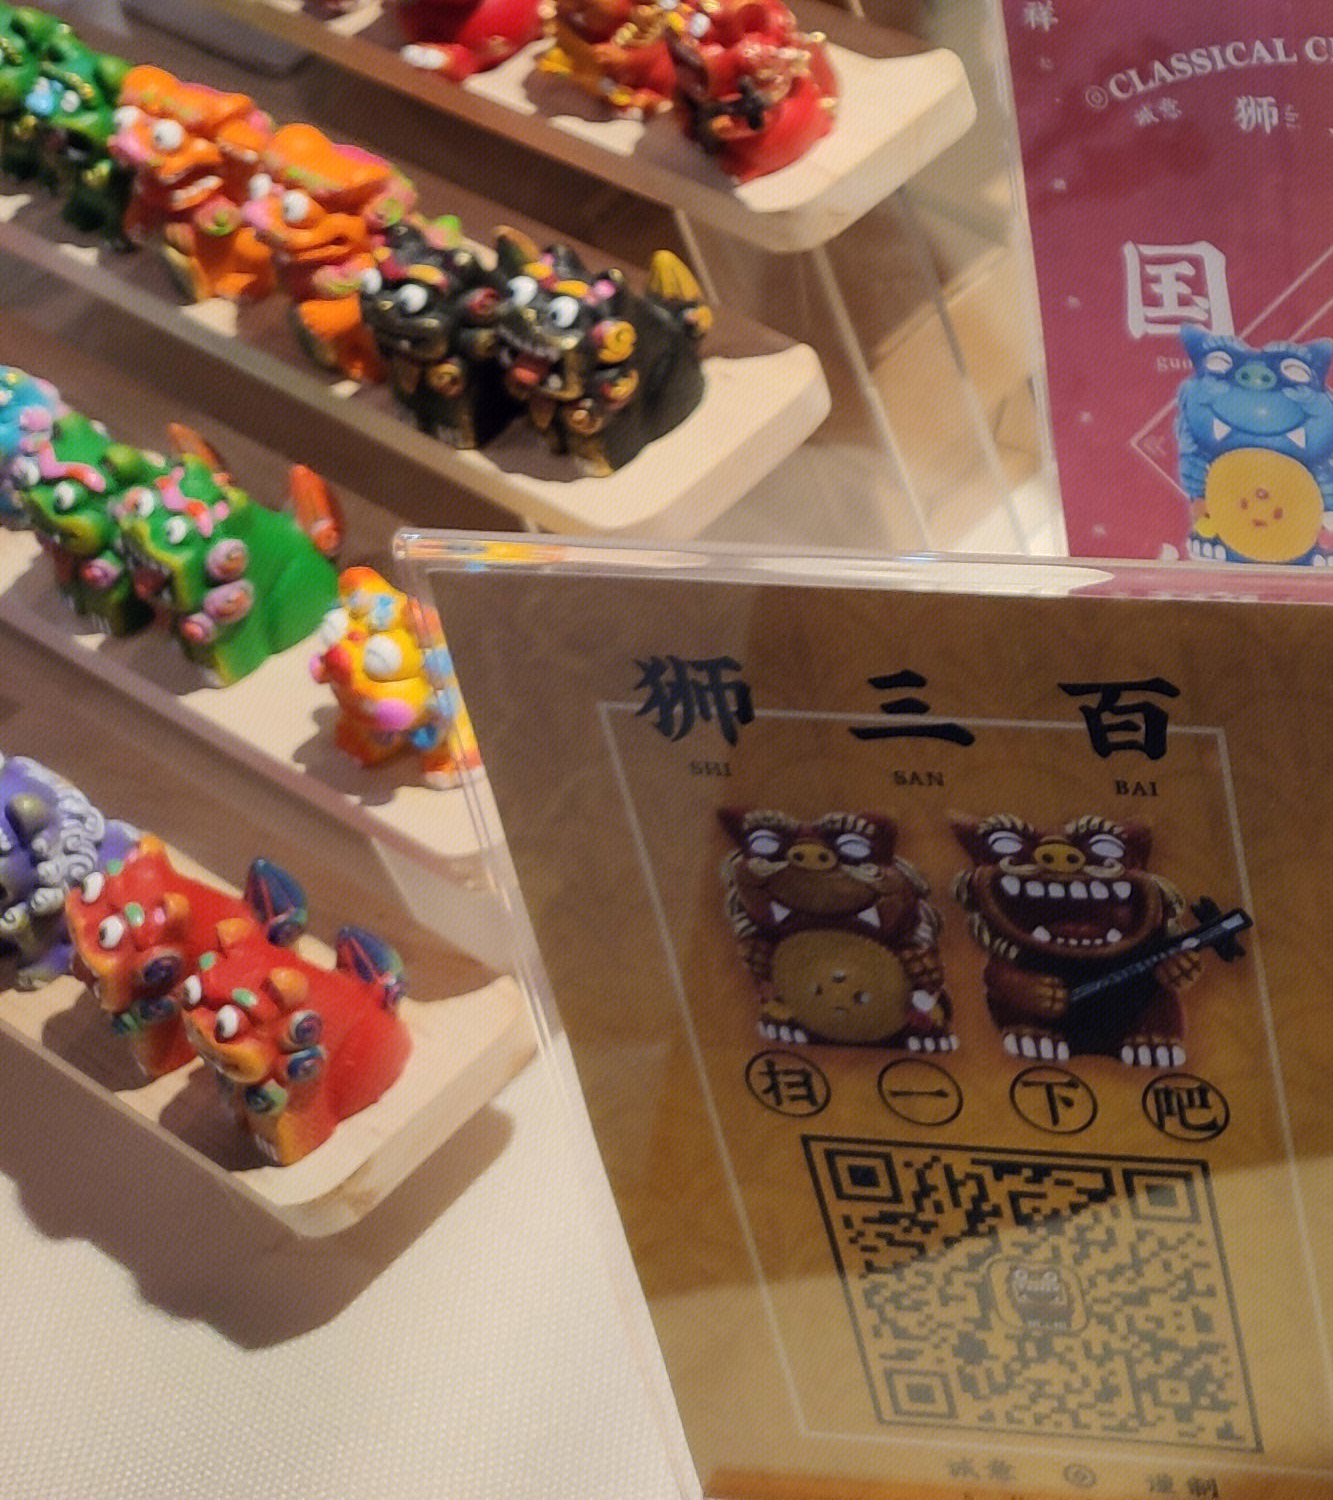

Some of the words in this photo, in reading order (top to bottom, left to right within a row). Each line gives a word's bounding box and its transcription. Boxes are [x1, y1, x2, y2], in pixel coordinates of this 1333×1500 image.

[1107, 37, 1298, 100] CLASSICAL
[893, 770, 945, 788] SAN
[1114, 780, 1158, 797] BAI
